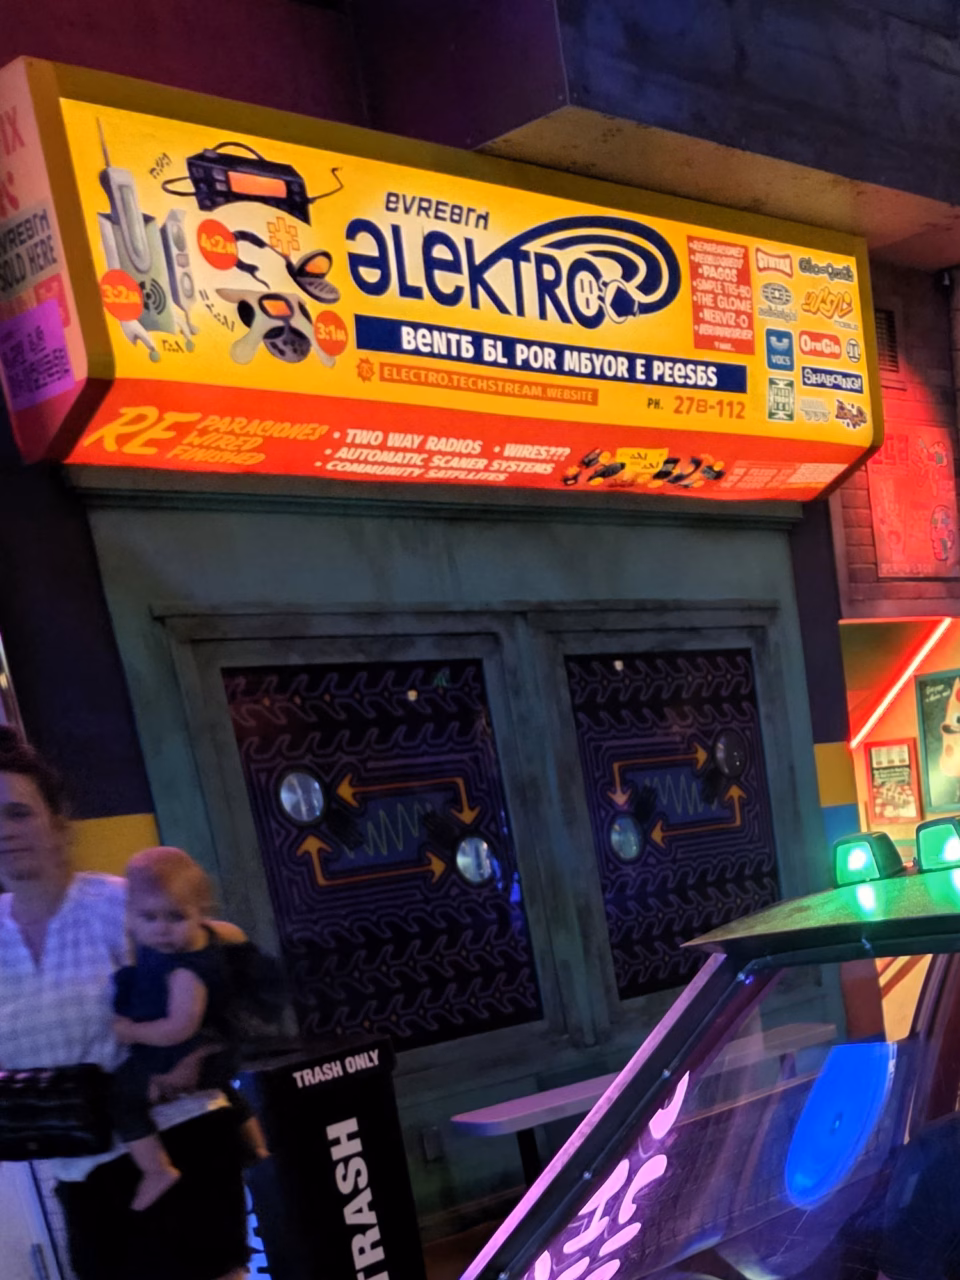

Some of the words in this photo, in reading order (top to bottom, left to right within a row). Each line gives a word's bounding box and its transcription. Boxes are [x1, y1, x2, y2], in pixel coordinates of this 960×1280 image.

[26, 236, 58, 277] HERE
[702, 264, 738, 282] PAGOS
[696, 291, 715, 307] THE
[515, 343, 557, 370] POR
[636, 358, 646, 379] E
[383, 365, 593, 402] ELECTRO.TECHSTREAM.WEBSITE
[647, 398, 664, 410] PH.
[82, 405, 203, 455] RE
[181, 430, 264, 451] WIRED
[197, 415, 330, 441] PARACIONES
[345, 428, 384, 446] TWO
[387, 432, 423, 449] WAY
[425, 436, 484, 455] RADIOS
[503, 443, 572, 462] WIRES???
[325, 461, 427, 479] COMMUNITY
[334, 446, 428, 466] AUTOMATIC
[492, 459, 556, 475] SYSTEMS
[292, 1062, 344, 1088] TRASH
[344, 1049, 381, 1074] ONLY
